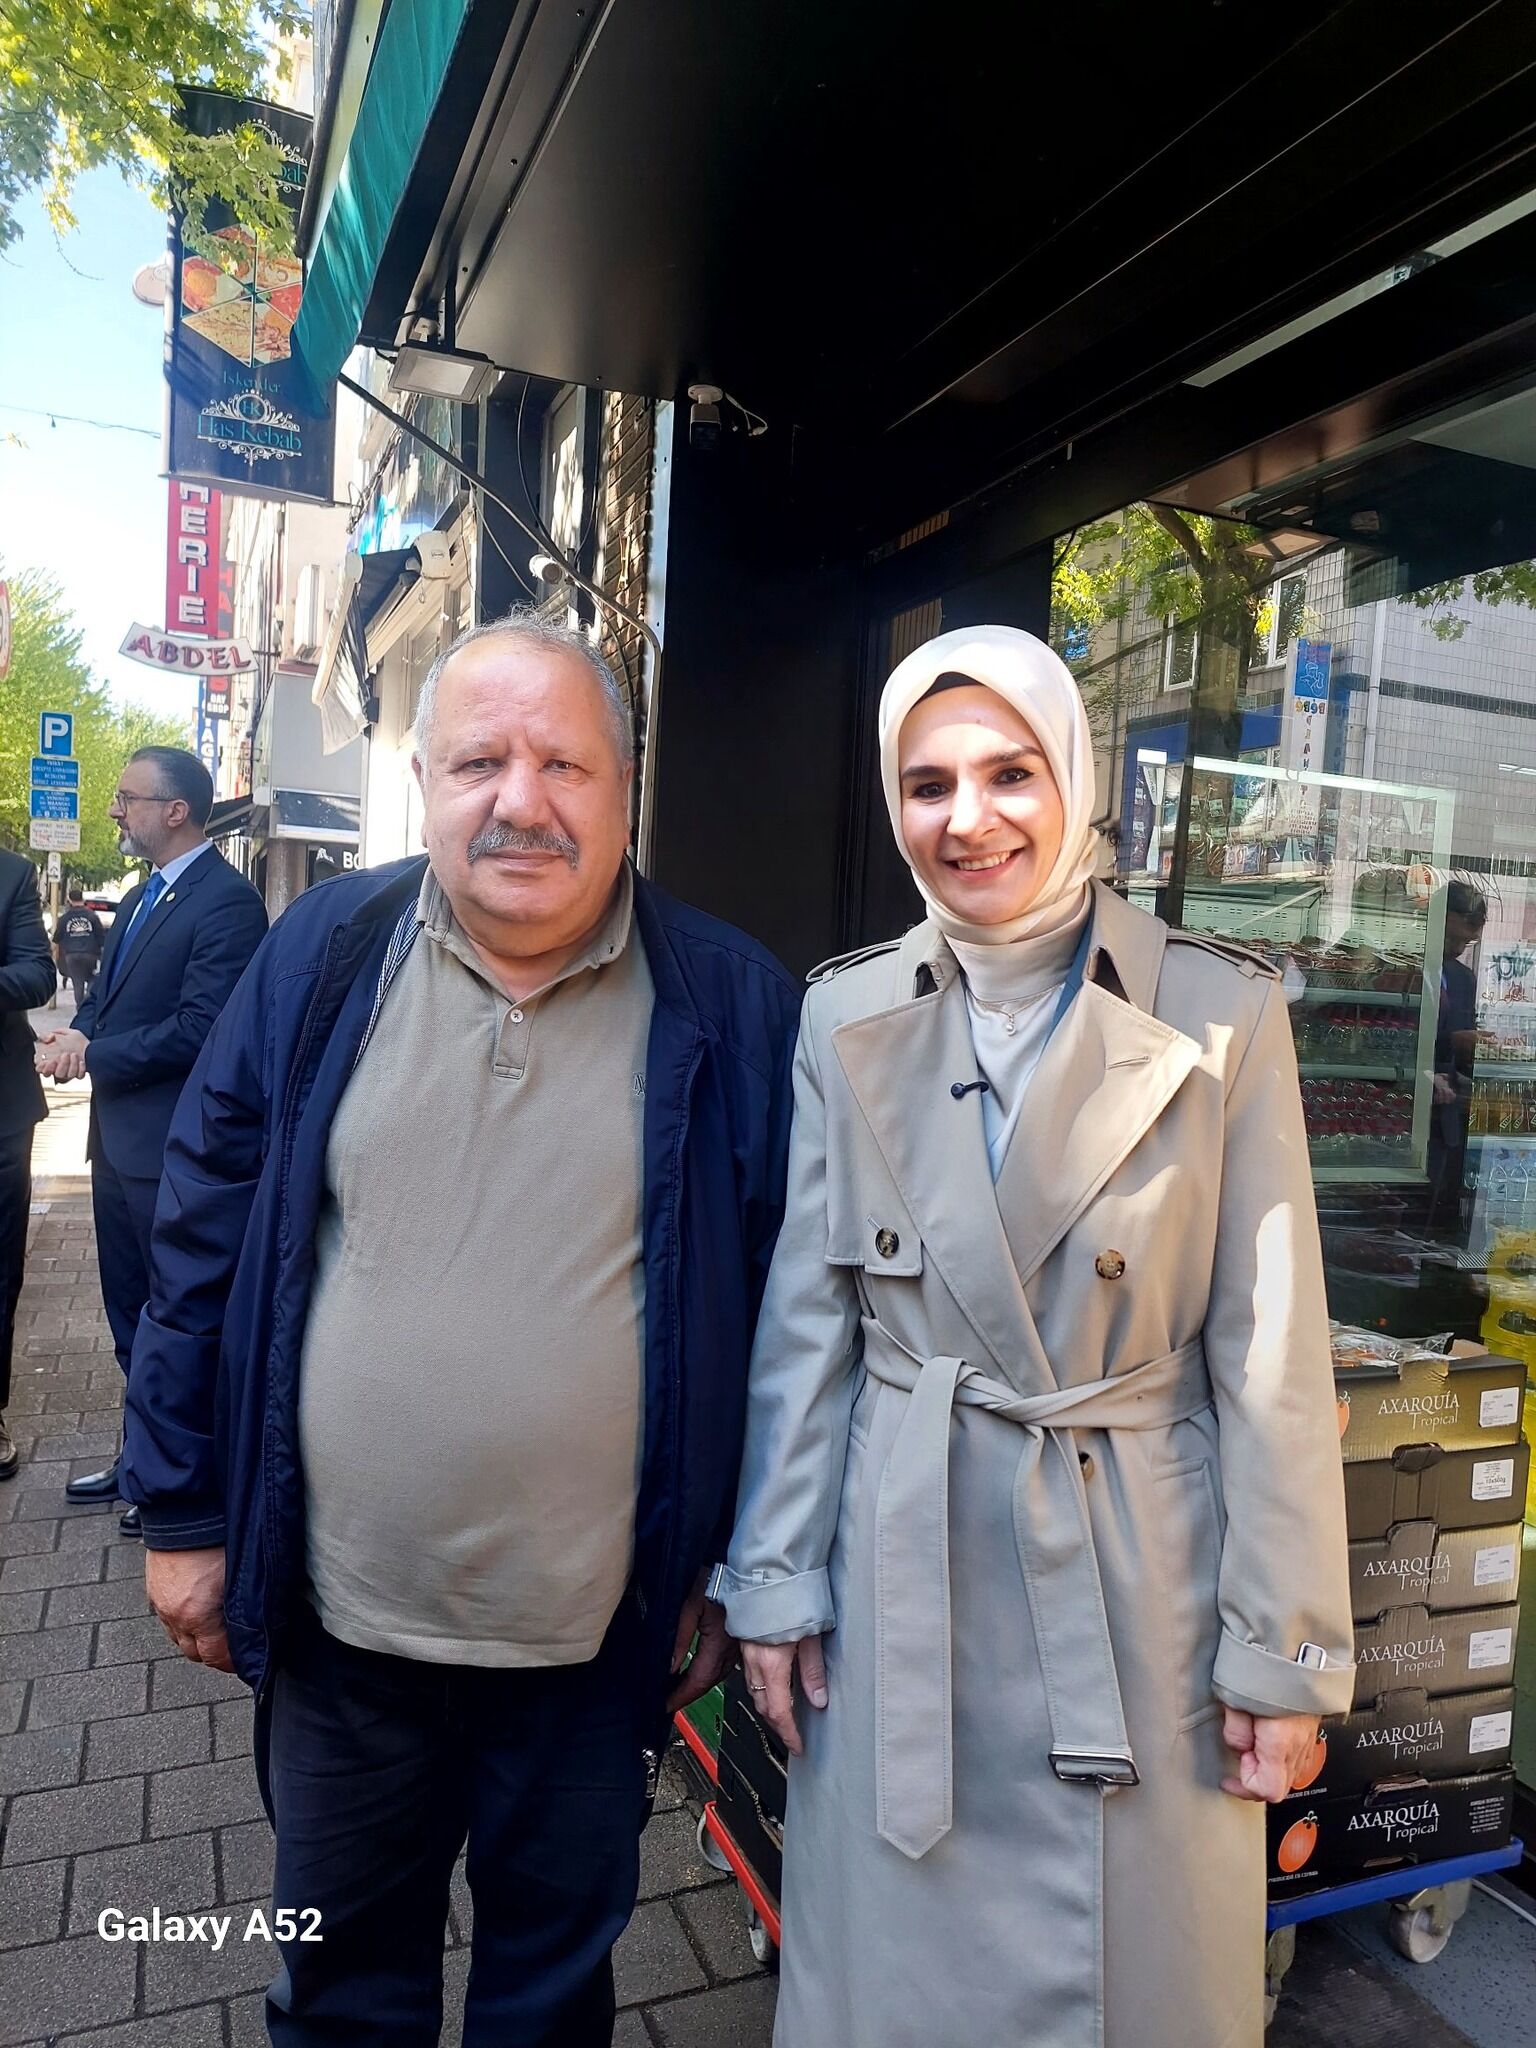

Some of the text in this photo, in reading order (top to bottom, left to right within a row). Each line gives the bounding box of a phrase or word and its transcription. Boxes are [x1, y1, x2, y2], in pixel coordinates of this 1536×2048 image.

[197, 414, 302, 450] Has Kebab
[127, 634, 251, 670] ABDEL
[44, 717, 69, 749] P
[1377, 1390, 1460, 1415] AXARQUÍA
[1409, 1407, 1458, 1433] Tropical
[1363, 1551, 1451, 1576] AXARQUÍA
[1397, 1567, 1450, 1593] Tropical
[1357, 1634, 1446, 1664] AXARQUÍA
[1391, 1652, 1444, 1678] Tropical
[1356, 1717, 1444, 1748] AXARQUÍA
[1389, 1734, 1443, 1760] Tropical
[1347, 1800, 1440, 1831] AXARQUÍA
[1381, 1816, 1438, 1843] Tropical
